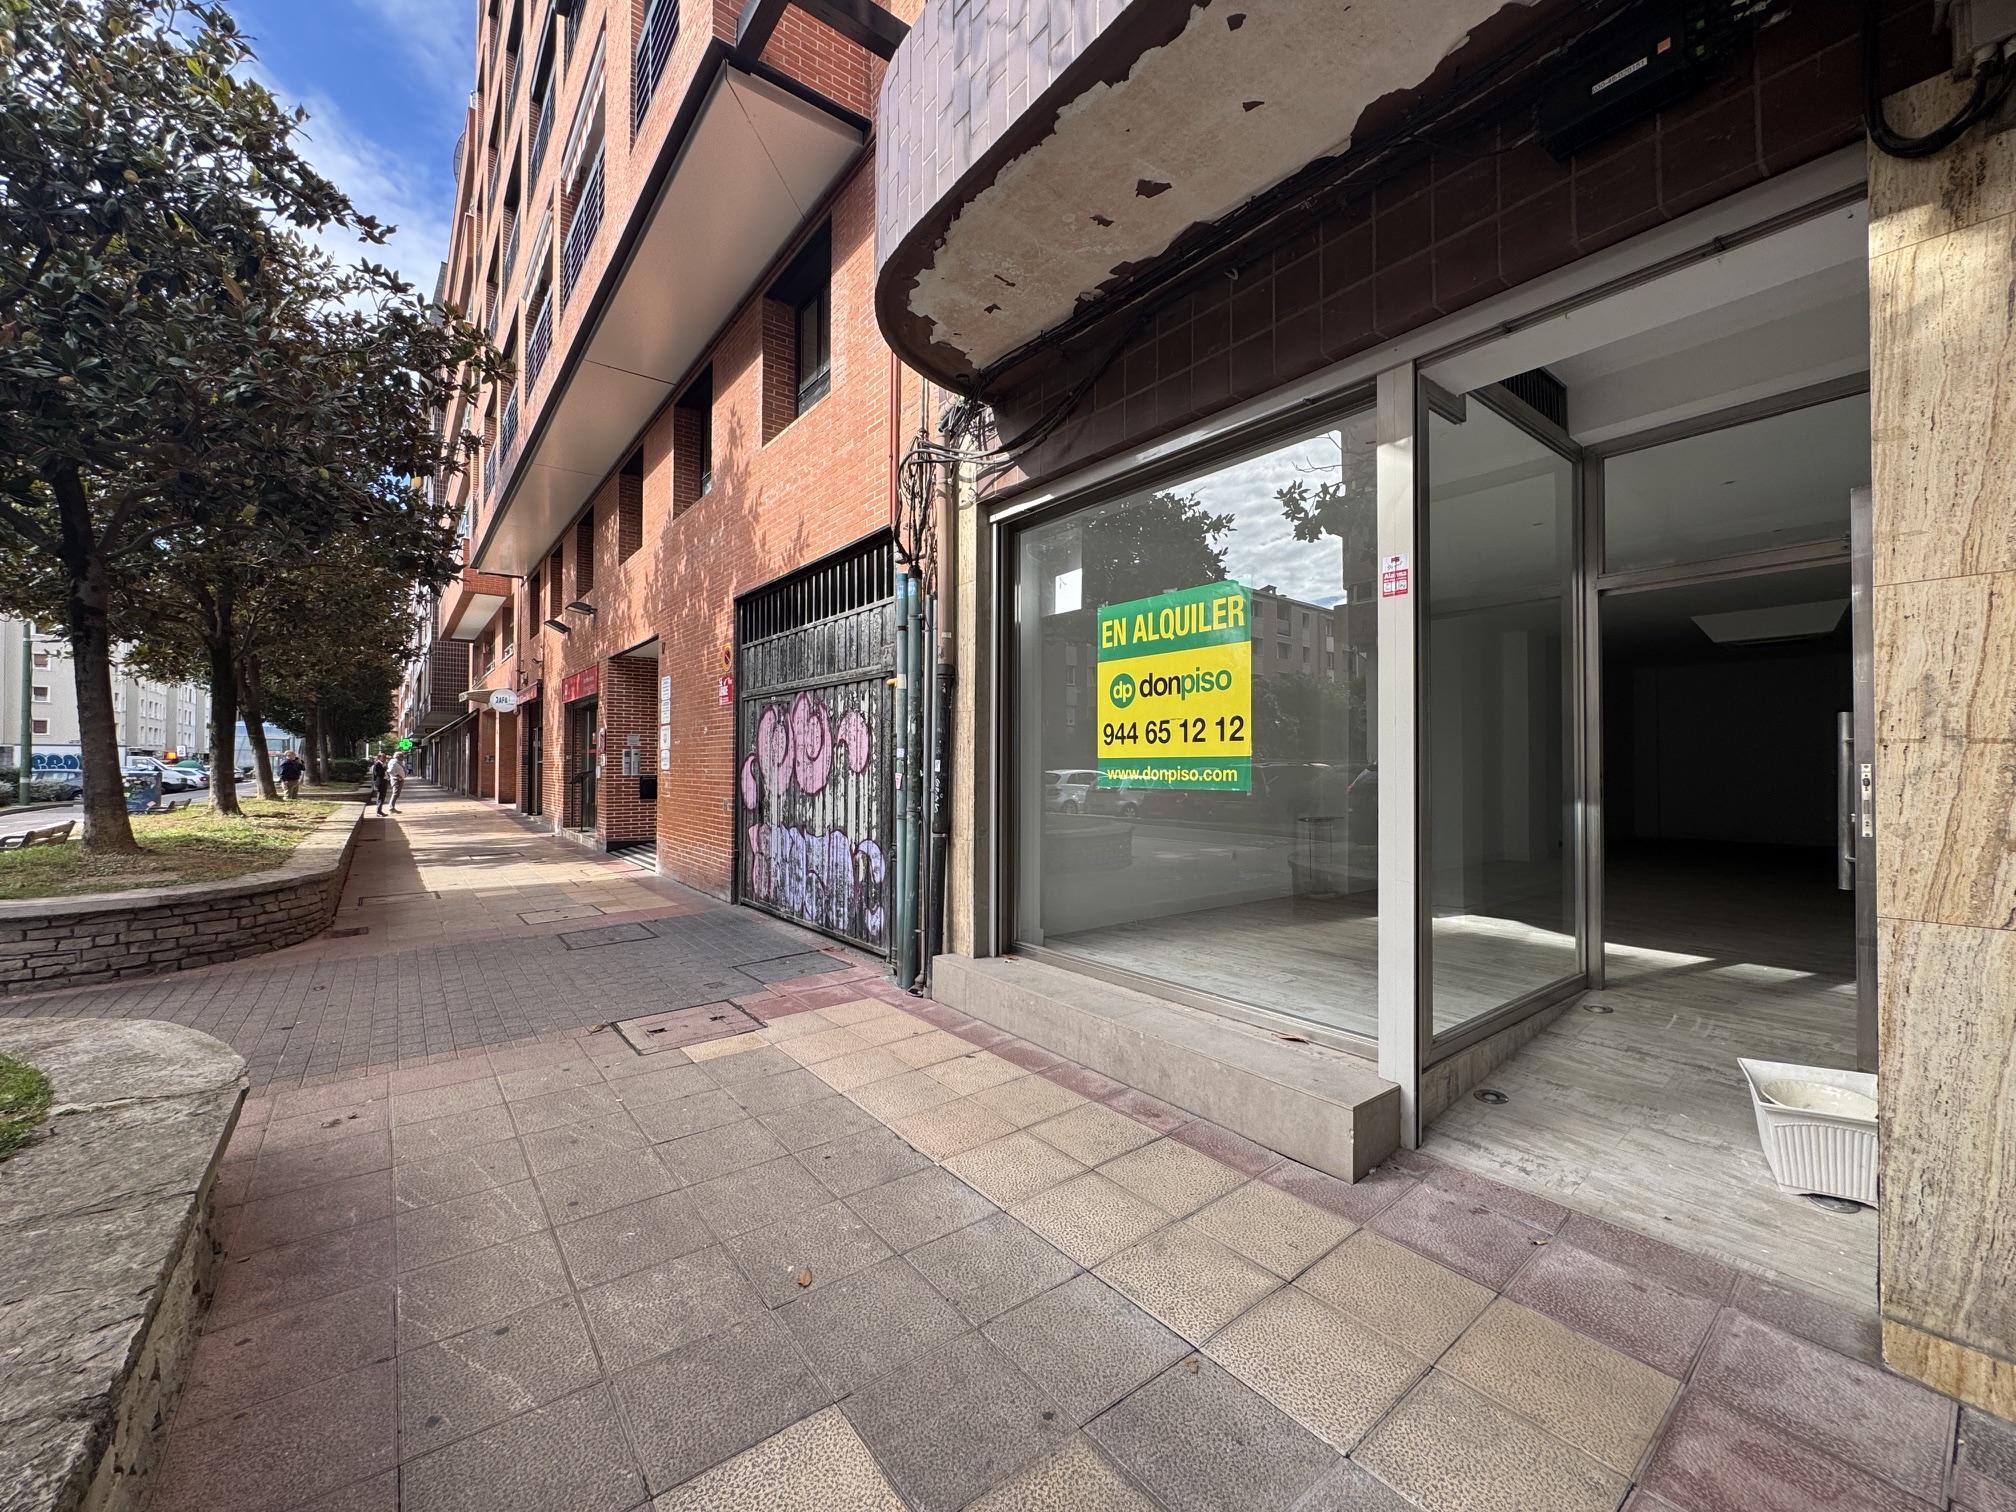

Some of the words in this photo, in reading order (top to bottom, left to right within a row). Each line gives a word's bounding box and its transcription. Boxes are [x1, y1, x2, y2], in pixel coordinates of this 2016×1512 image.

[1102, 617, 1127, 649] EN
[1132, 594, 1245, 641] ALQUILER
[1139, 666, 1233, 701] donpiso
[1103, 722, 1139, 746] 944
[1145, 719, 1171, 745] 65
[1179, 717, 1206, 743] 12
[1215, 715, 1245, 742] 12
[1107, 765, 1238, 784] www.donpiso.com
